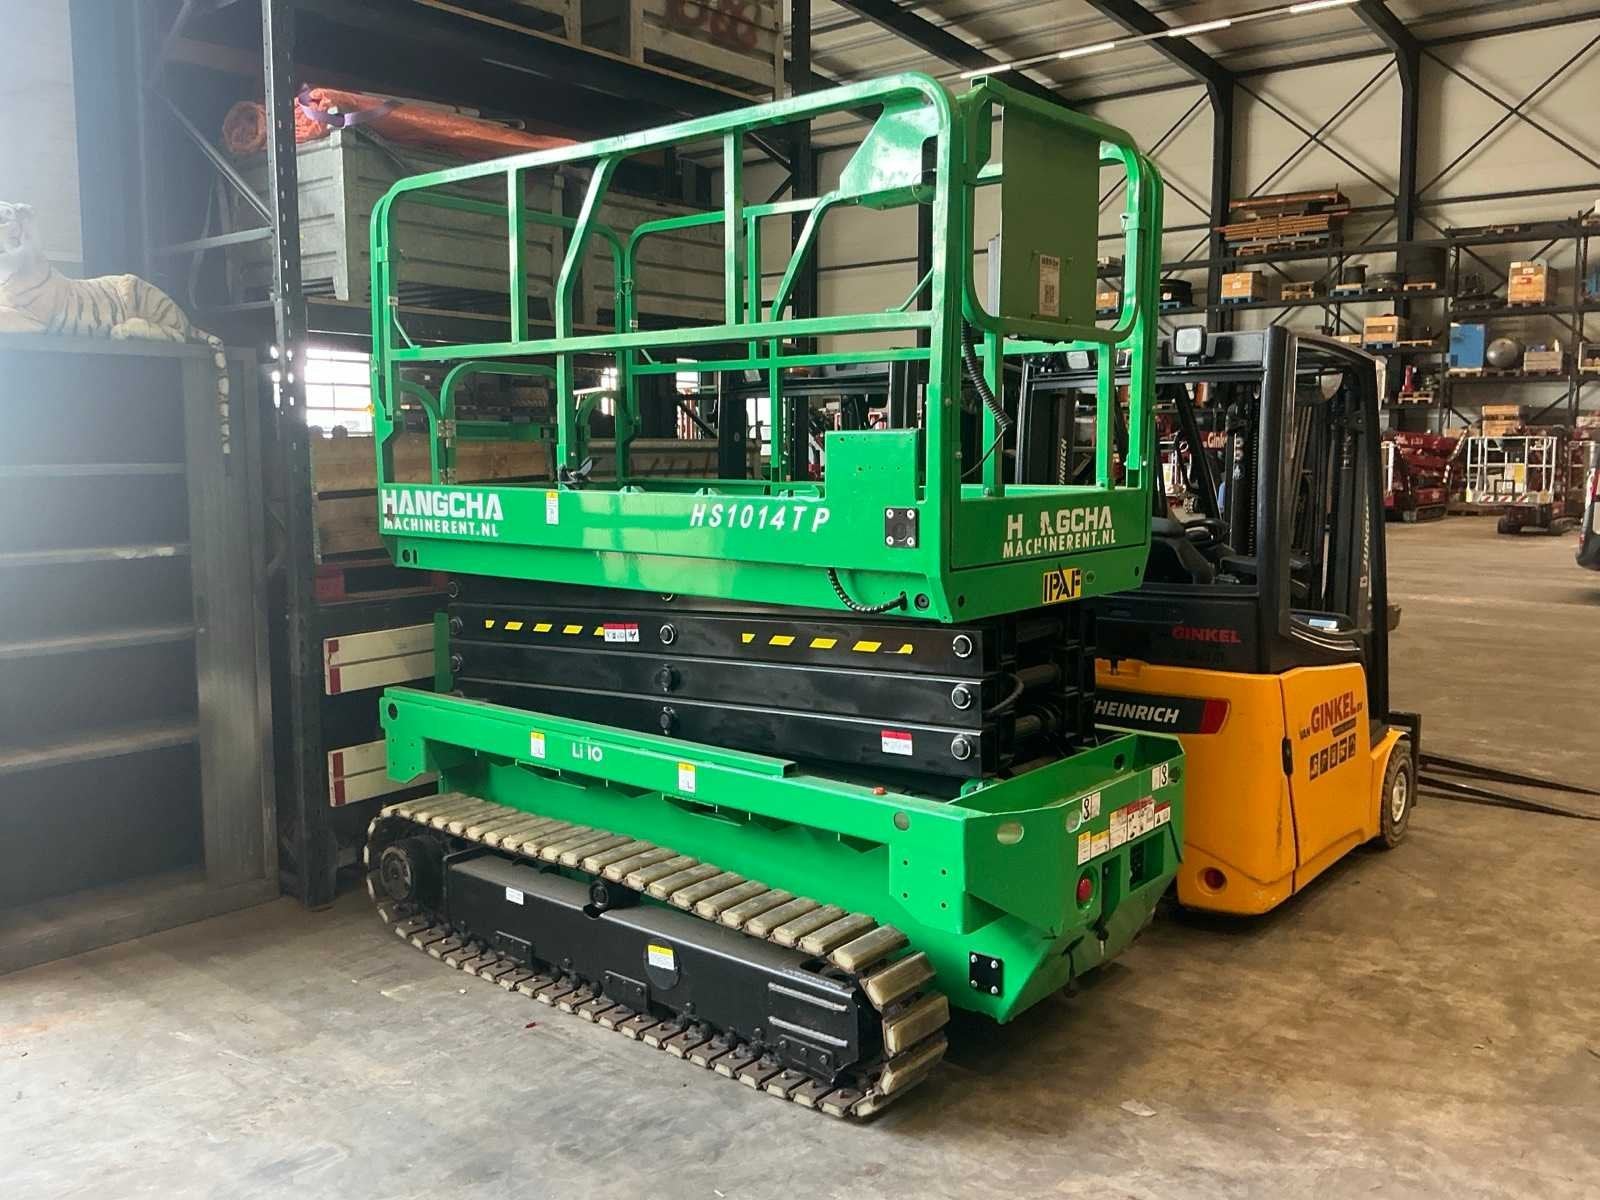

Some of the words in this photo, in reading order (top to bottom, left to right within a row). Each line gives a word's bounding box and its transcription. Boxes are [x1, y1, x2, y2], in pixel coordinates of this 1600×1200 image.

[1058, 438, 1068, 486] INRICH
[381, 489, 504, 521] HANGCHA
[383, 518, 499, 537] MACHINERENT.NL
[1002, 528, 1116, 559] MACHINERENT.NL
[1044, 564, 1083, 603] IPAF
[1171, 626, 1242, 644] GINKEL
[1094, 700, 1180, 724] HEINRICH
[1311, 691, 1357, 733] GINKEL
